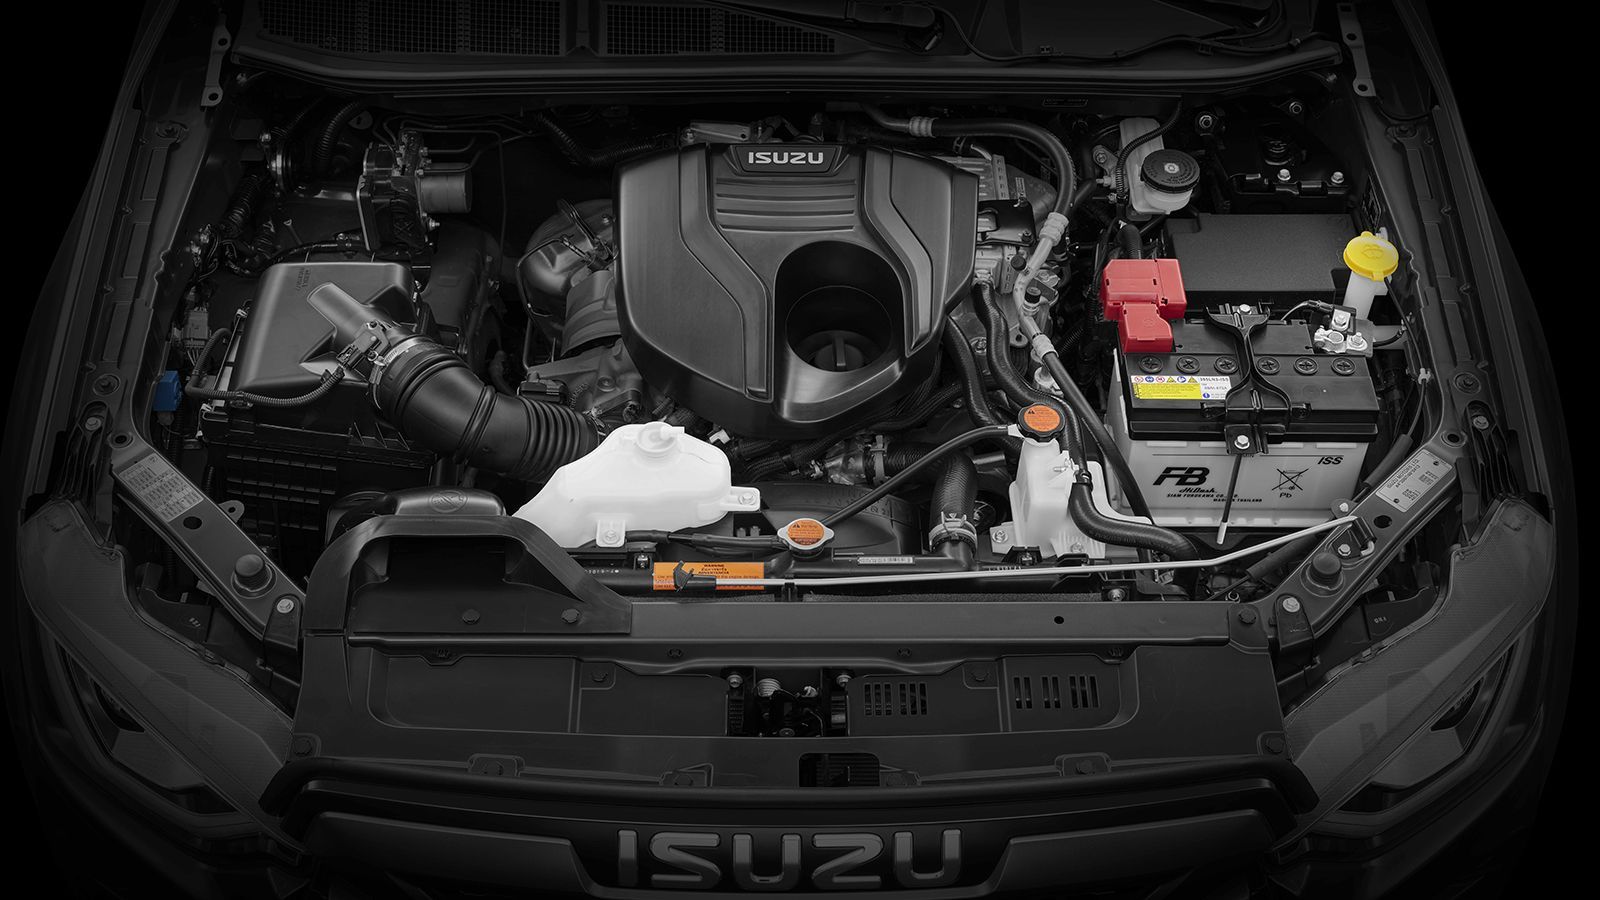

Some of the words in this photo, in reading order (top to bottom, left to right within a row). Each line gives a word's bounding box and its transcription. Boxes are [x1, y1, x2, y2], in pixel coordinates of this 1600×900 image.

[749, 152, 823, 164] ISUZU
[1317, 456, 1343, 465] ISS
[1153, 467, 1210, 486] FB
[618, 829, 962, 891] ISUZU
